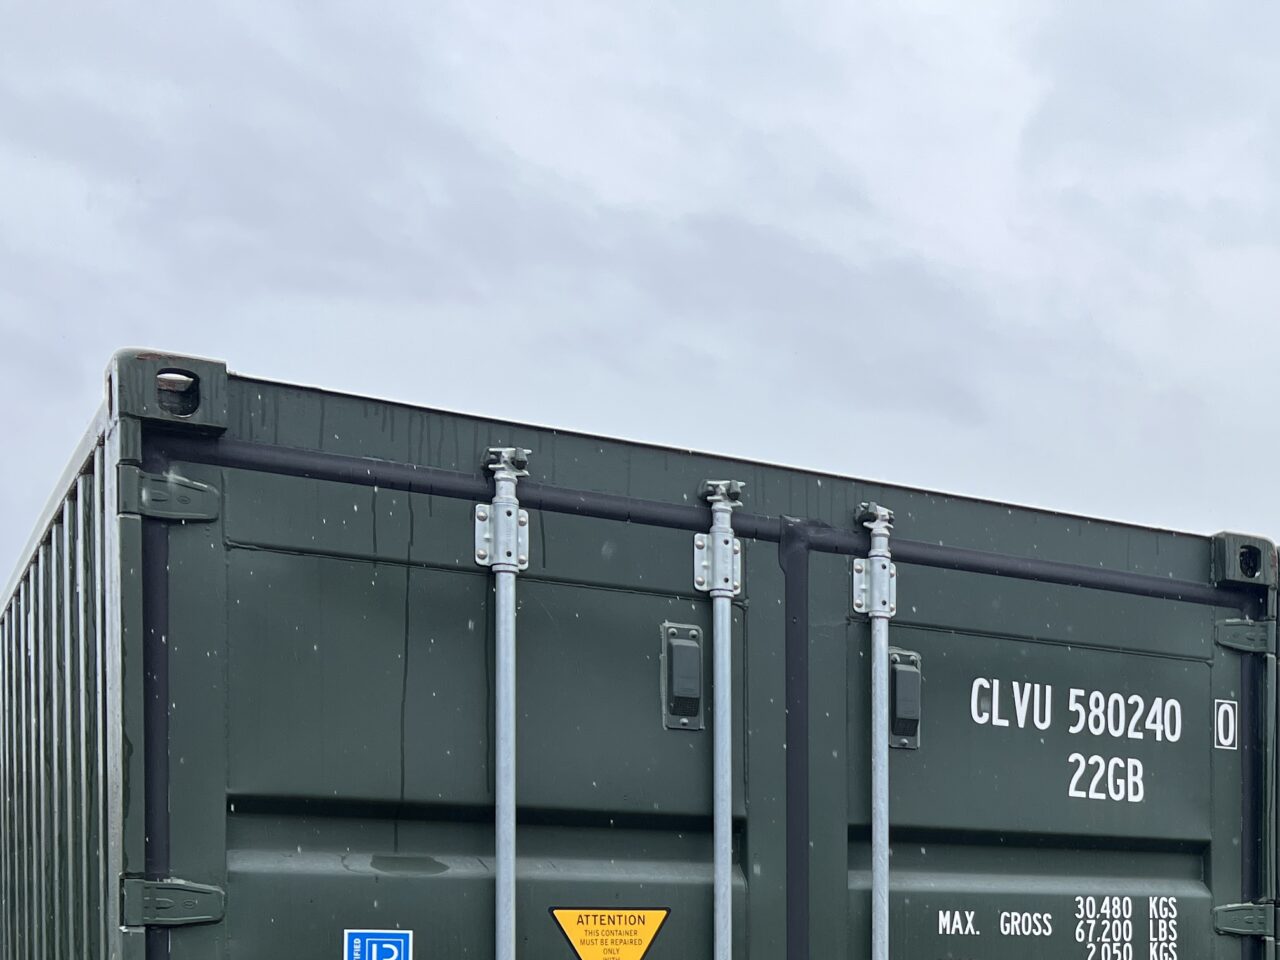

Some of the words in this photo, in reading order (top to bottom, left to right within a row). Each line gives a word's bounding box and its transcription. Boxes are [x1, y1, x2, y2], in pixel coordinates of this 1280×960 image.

[970, 677, 1052, 730] CLVU
[1068, 688, 1182, 743] 580240
[1217, 702, 1235, 747] 0
[1068, 752, 1145, 802] 22GB
[1149, 896, 1178, 919] KGS
[576, 914, 646, 926] ATTENTION
[938, 910, 981, 935] MAX.
[1000, 911, 1053, 936] GROSS
[1149, 919, 1178, 942] LBS
[580, 938, 598, 946] MUST
[600, 938, 609, 946] BE
[610, 938, 643, 946] REPAIRED
[584, 929, 600, 937] THIS
[601, 929, 638, 937] CONTAINER
